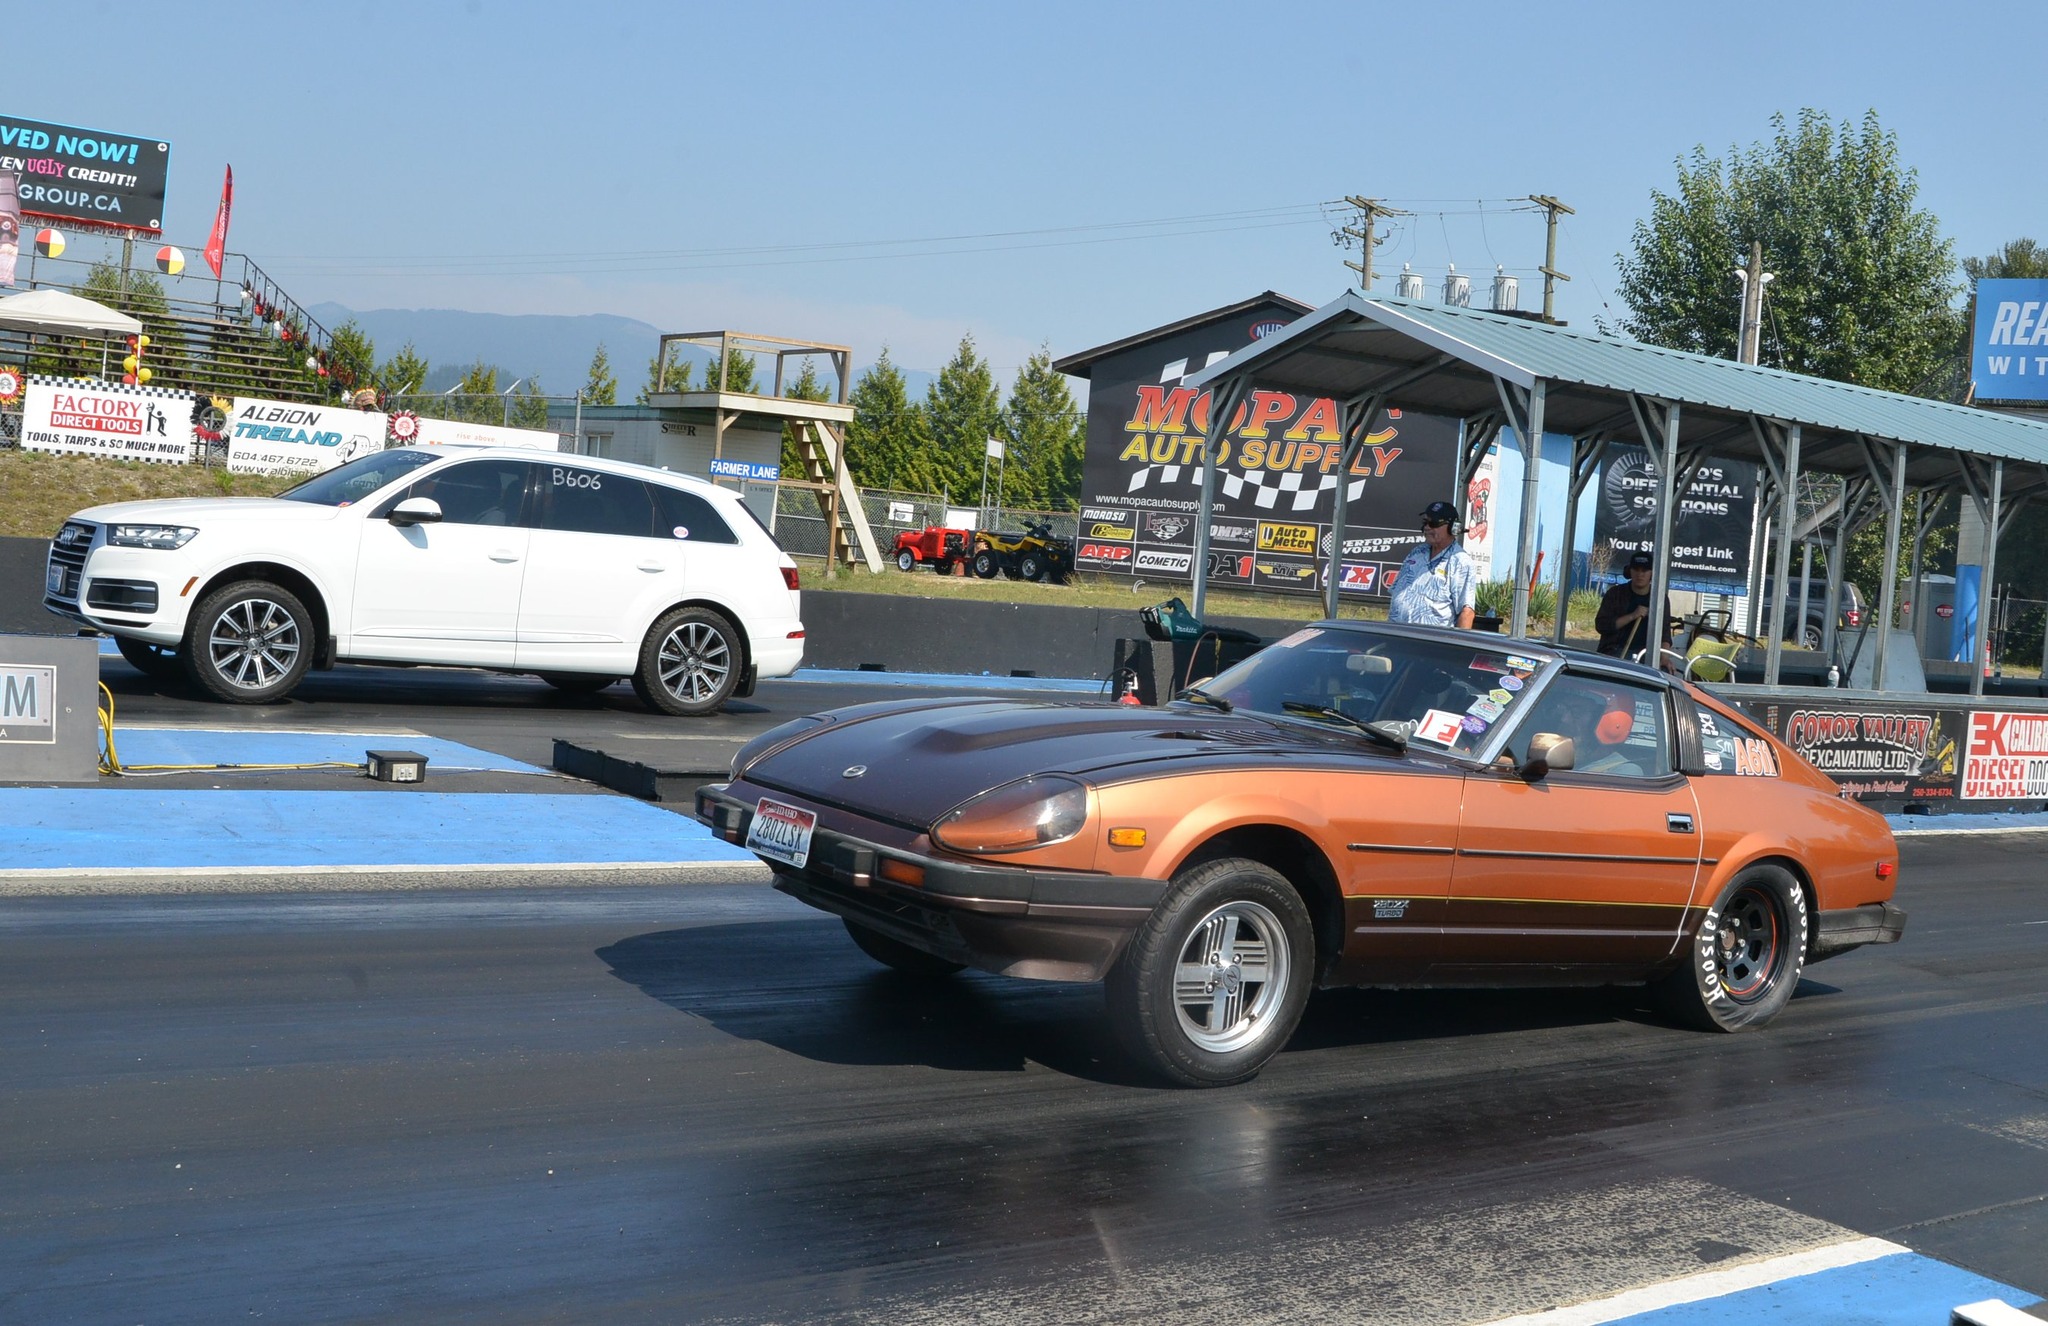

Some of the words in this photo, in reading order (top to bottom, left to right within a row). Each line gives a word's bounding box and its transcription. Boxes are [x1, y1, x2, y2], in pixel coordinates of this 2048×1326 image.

[56, 135, 139, 164] NOW!
[27, 158, 66, 178] UGLY
[67, 167, 137, 187] CREDIT!!
[53, 394, 142, 418] FACTORY
[52, 413, 98, 429] DIRECT
[100, 417, 141, 433] TOOLS
[27, 431, 62, 444] TOOLS,
[64, 435, 97, 447] TARPS
[98, 439, 106, 448] &
[108, 439, 123, 449] SO
[125, 441, 156, 453] MUCH
[157, 443, 186, 455] MORE
[234, 422, 343, 447] TIRELAND
[233, 451, 318, 467] 604.467.6722
[1119, 434, 1231, 465] AUTO
[1238, 440, 1403, 477] SUPPLY
[552, 467, 602, 490] B606
[710, 461, 750, 477] FARMER
[751, 465, 778, 479] LANE
[1622, 476, 1744, 499] DIFFNTIAL
[1082, 509, 1126, 521] MOROSO
[1633, 495, 1729, 516] SOTIONS
[1210, 525, 1243, 539] OMP
[1275, 526, 1307, 538] Auto
[1343, 535, 1427, 547] ERFORMAN
[1078, 544, 1132, 560] ARP
[1274, 536, 1314, 549] Meter
[1609, 538, 1639, 551] Your
[1641, 541, 1704, 558] Stgest
[1706, 547, 1734, 560] Link
[1138, 555, 1189, 568] COMETIC
[1671, 561, 1737, 574] ifferentials.com
[1176, 625, 1198, 634] Makita
[1788, 713, 1860, 749] COMOX
[1861, 716, 1931, 757] VALLEY
[1810, 750, 1883, 769] EXCAVATING
[1965, 759, 2025, 797] DIESEL
